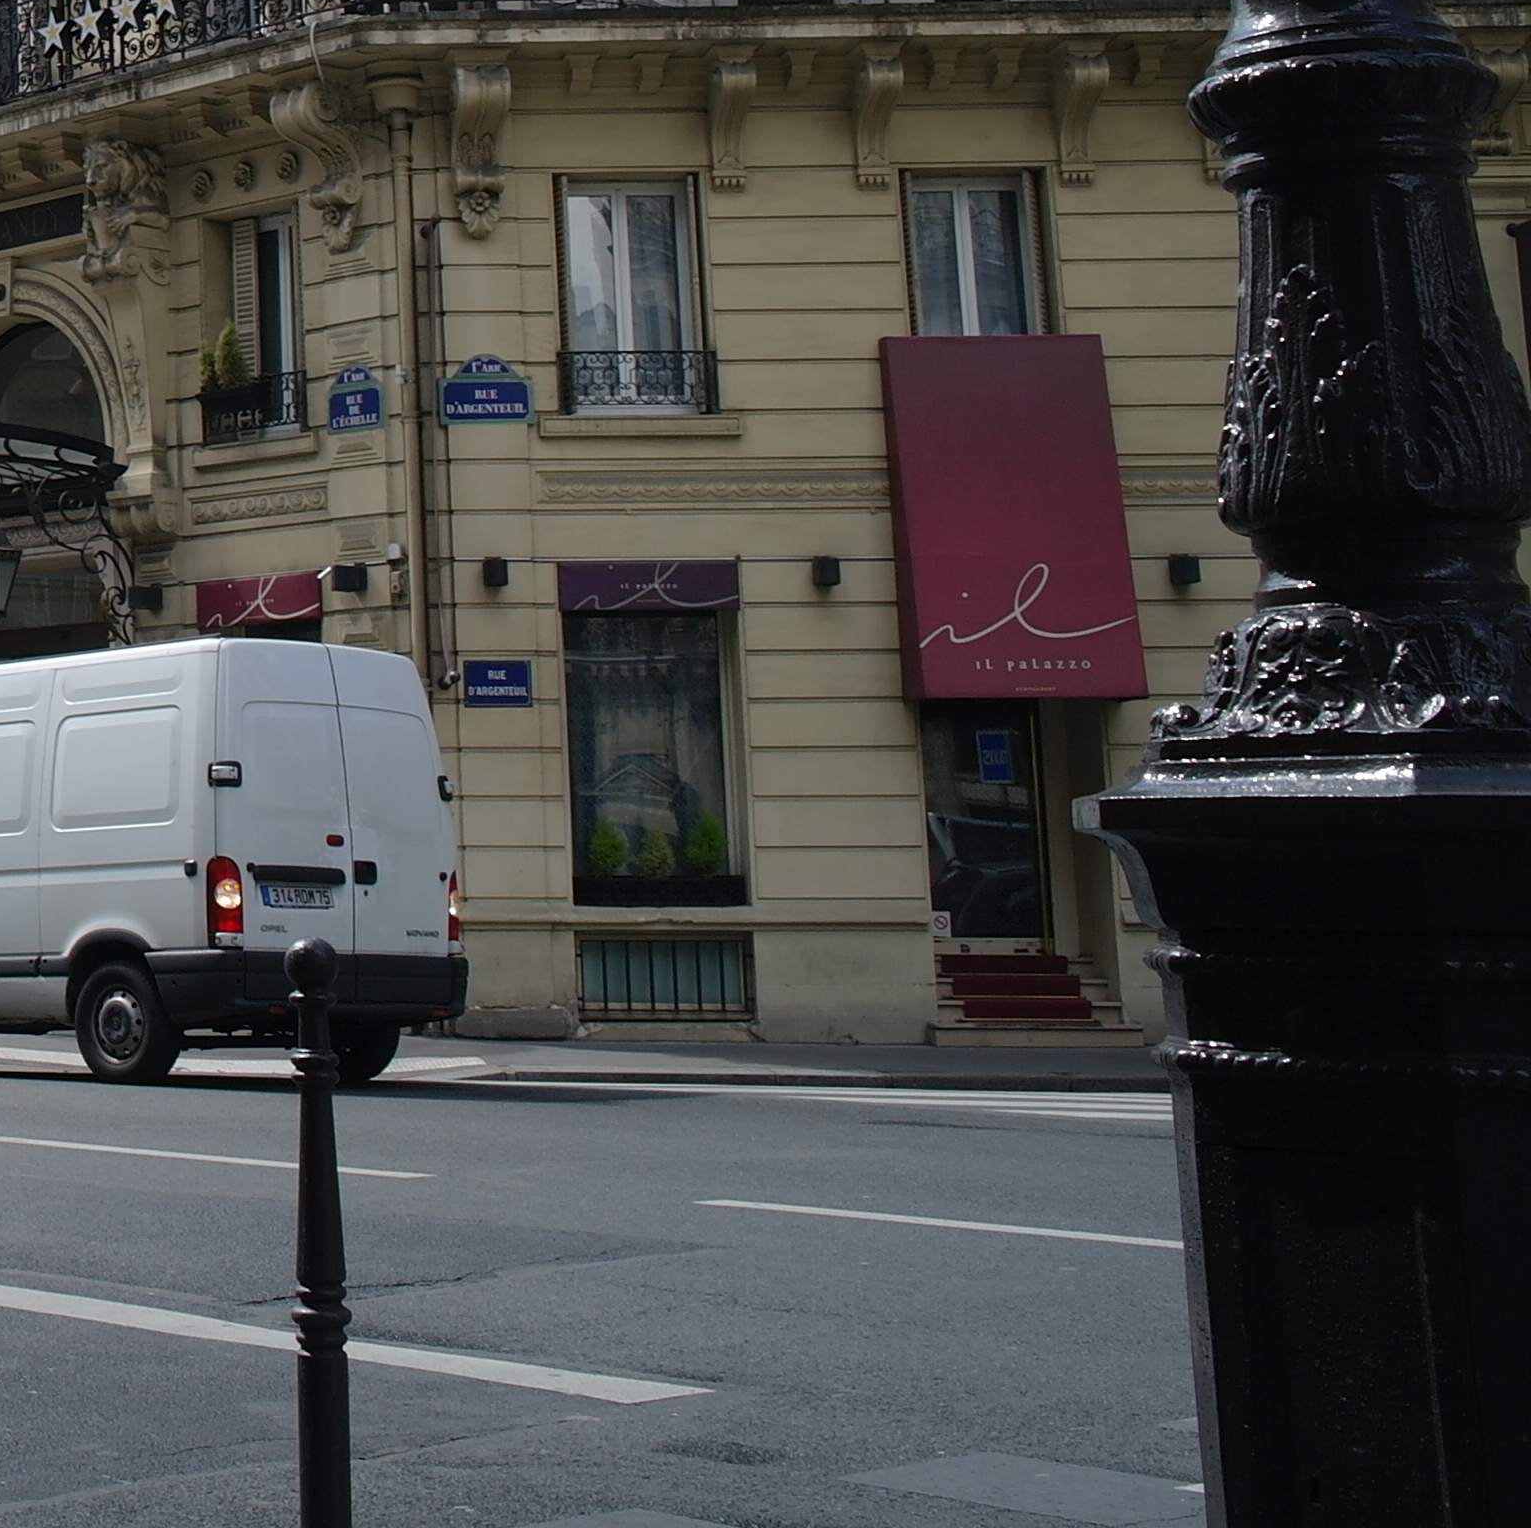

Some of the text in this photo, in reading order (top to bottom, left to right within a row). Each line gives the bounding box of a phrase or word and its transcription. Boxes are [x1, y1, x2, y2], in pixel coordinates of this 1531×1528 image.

[345, 393, 364, 405] RUE
[474, 389, 498, 400] RUE
[349, 404, 361, 415] DE
[446, 403, 527, 415] D'ARGENTEUIL
[332, 413, 378, 429] L'ÉCHELLE
[487, 670, 507, 680] RUE
[468, 685, 528, 697] D'ARGENTEUIL
[260, 924, 288, 933] OPEL
